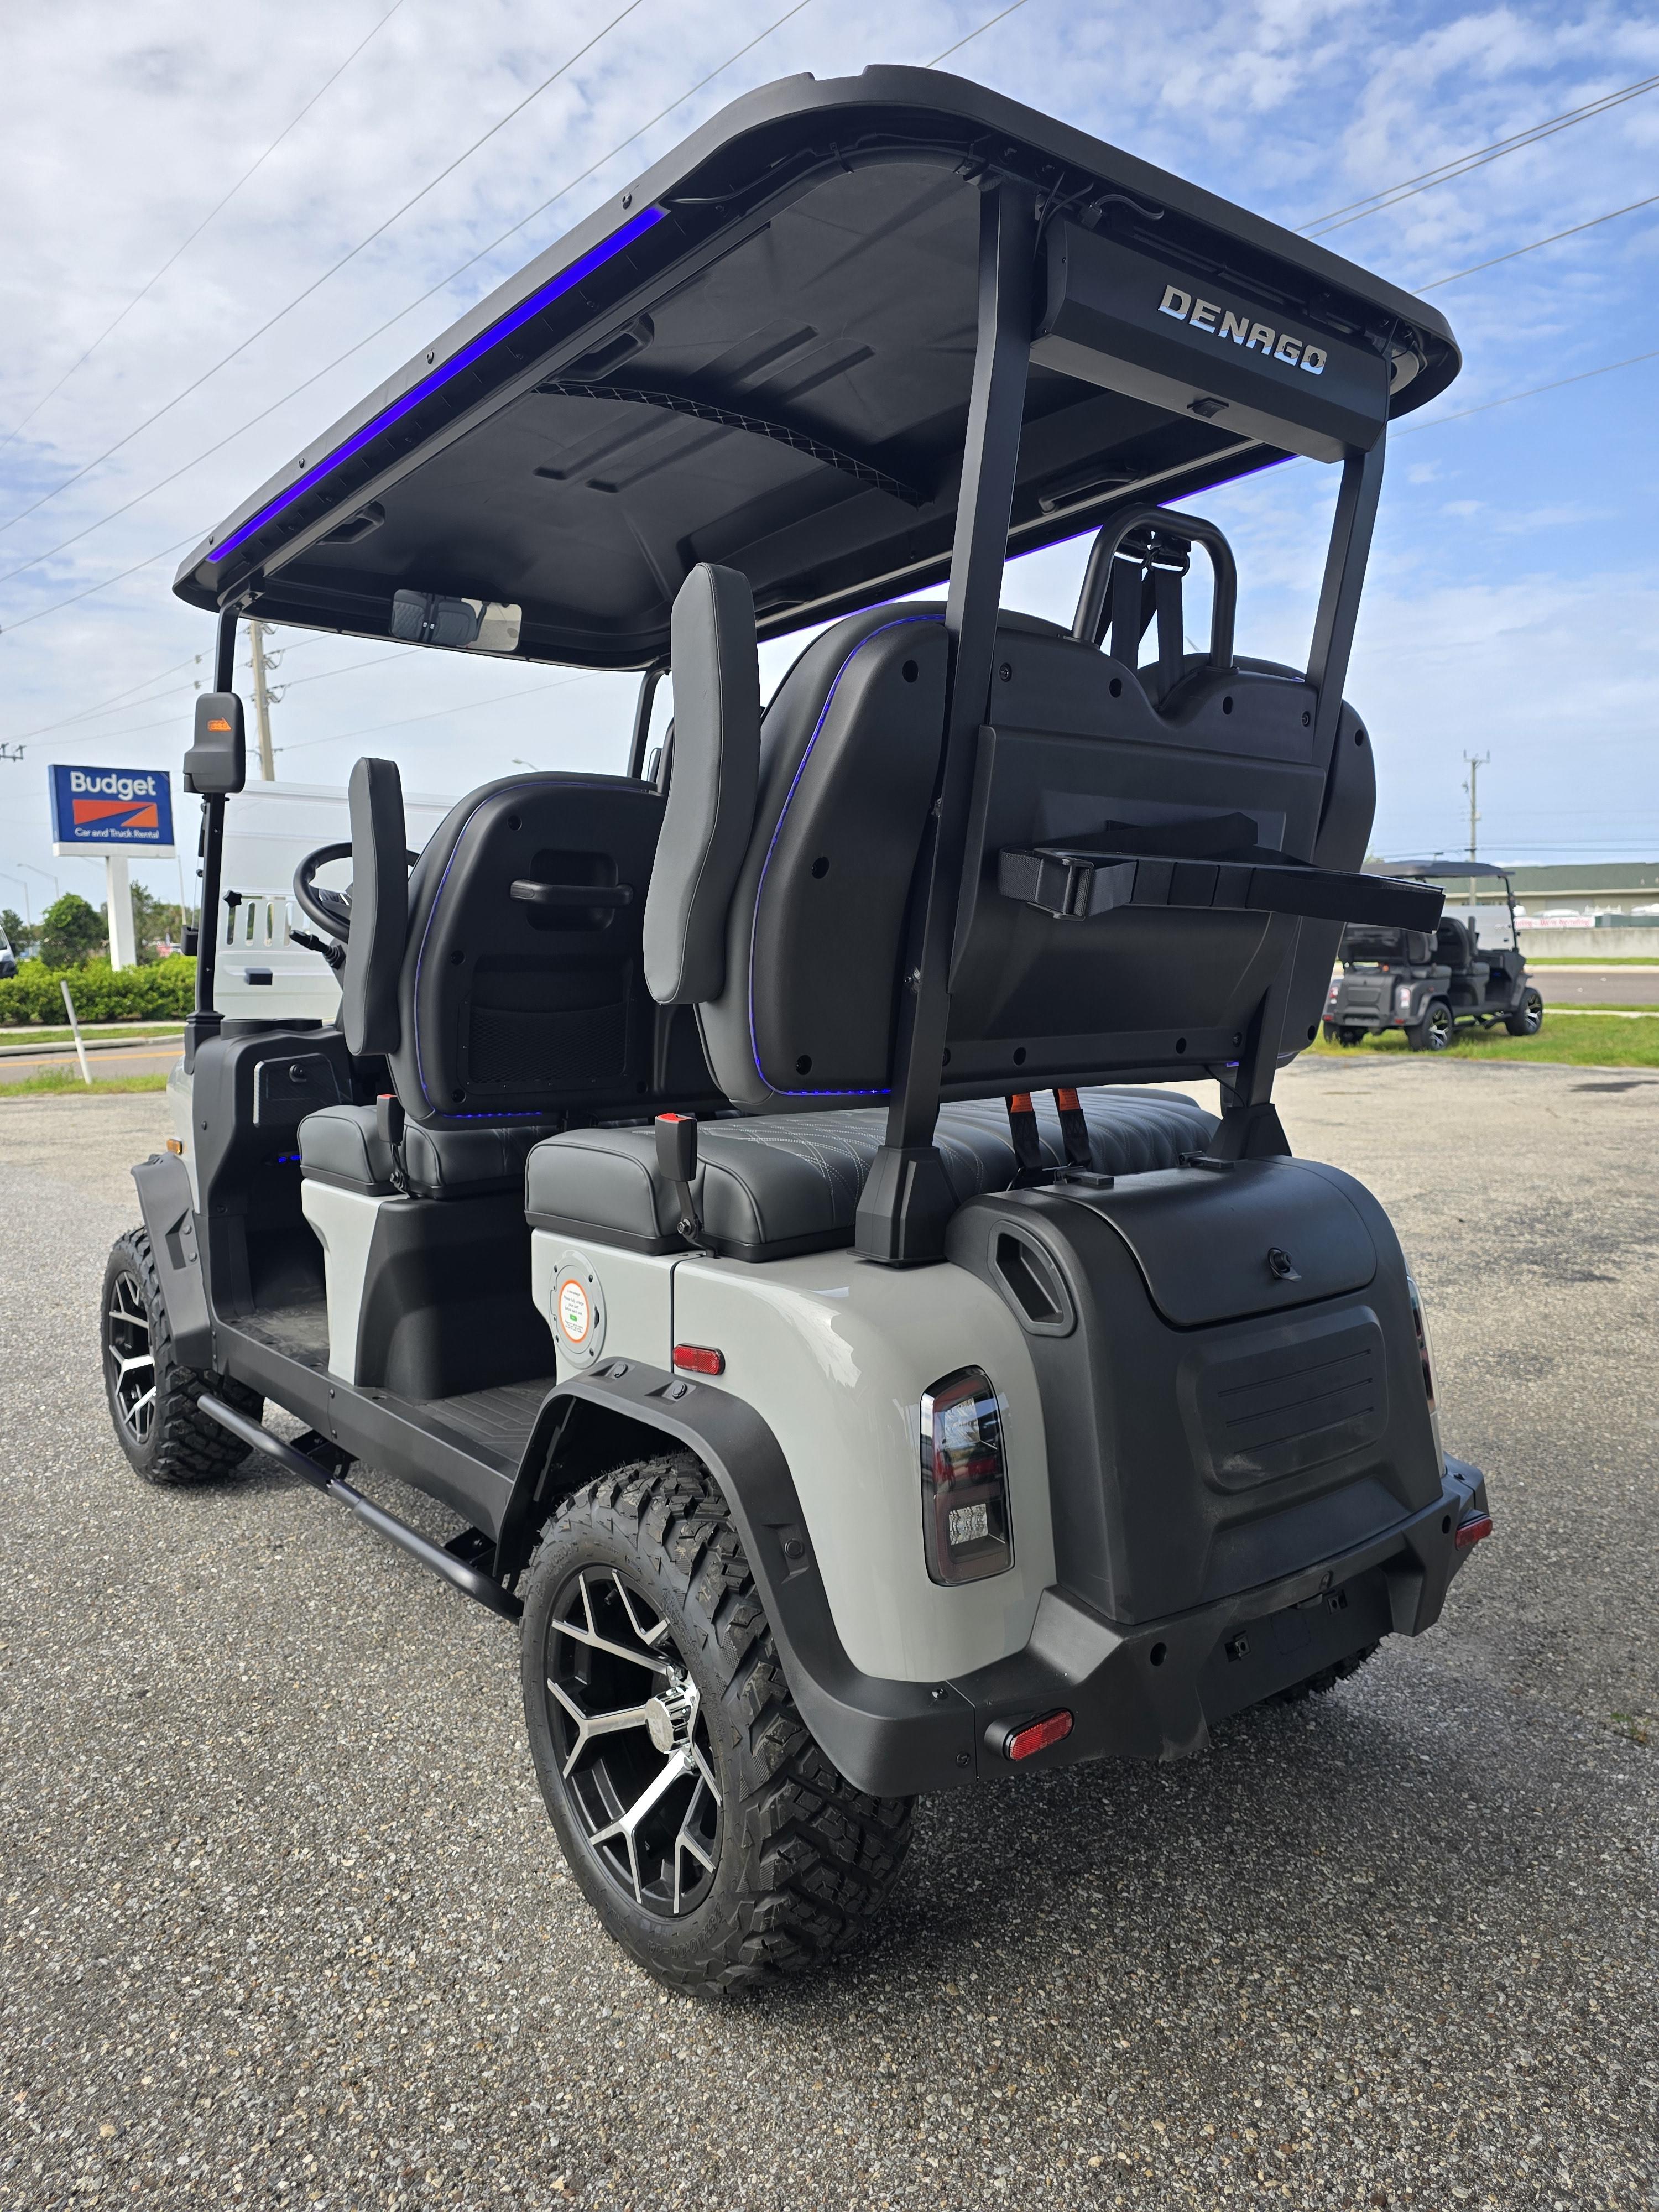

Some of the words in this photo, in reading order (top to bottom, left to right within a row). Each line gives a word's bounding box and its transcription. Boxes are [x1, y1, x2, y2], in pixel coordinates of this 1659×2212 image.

[1157, 284, 1327, 375] DENAGO
[70, 771, 156, 801] Budget
[74, 827, 90, 837] Car
[92, 828, 109, 837] and
[109, 828, 133, 838] Truck
[133, 830, 160, 839] Rental
